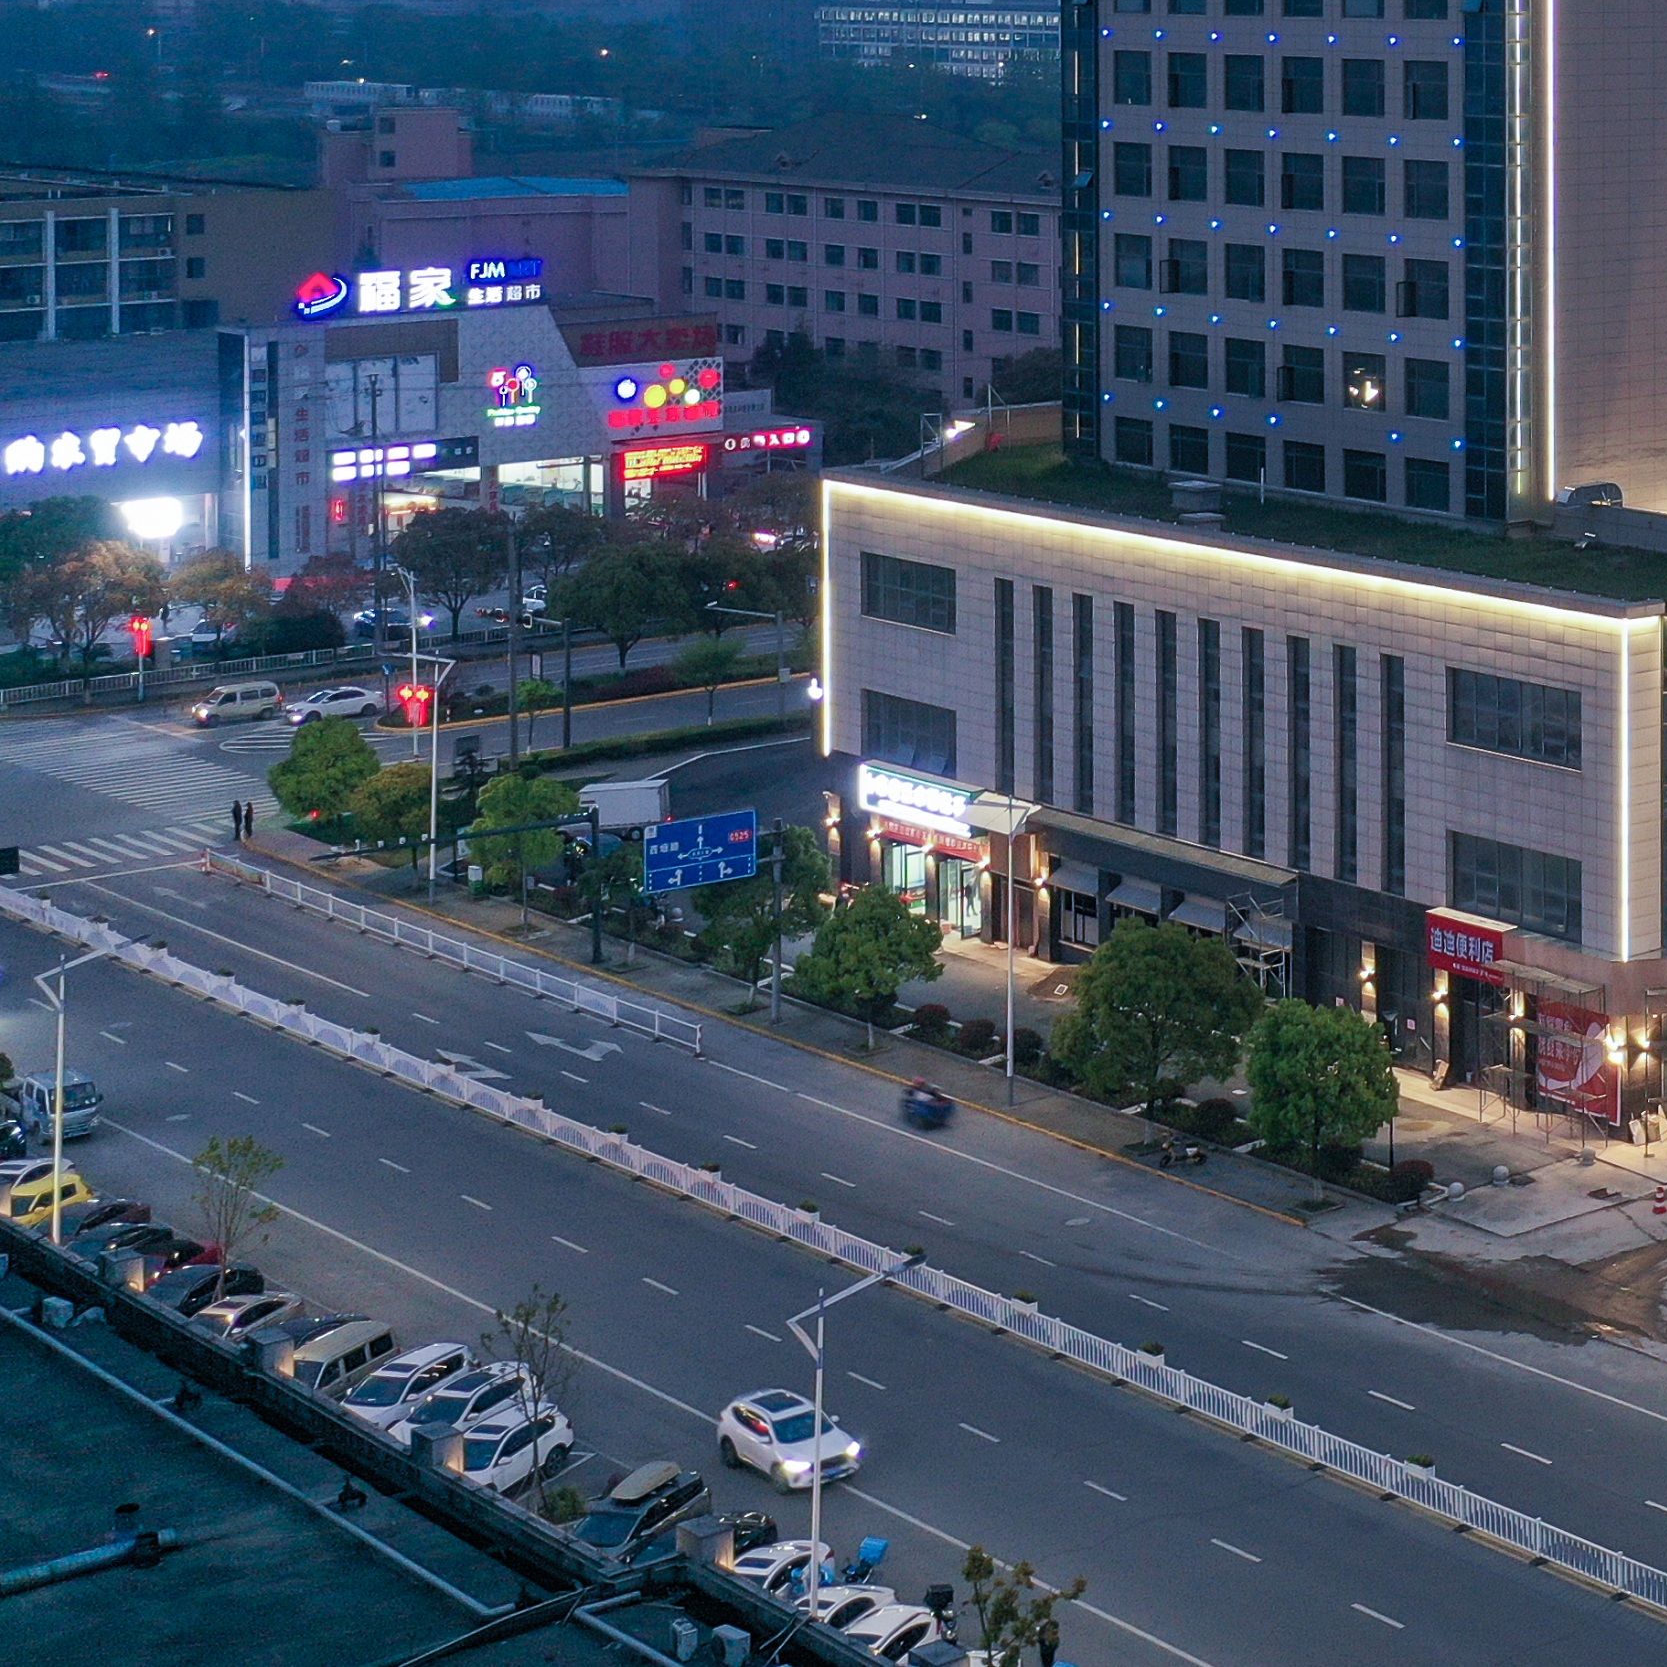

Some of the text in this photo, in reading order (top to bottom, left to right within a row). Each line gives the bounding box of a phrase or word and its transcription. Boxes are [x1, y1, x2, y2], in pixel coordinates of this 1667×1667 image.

[358, 267, 456, 312] 福家
[467, 284, 541, 305] 生活超市
[1430, 927, 1494, 965] 迪迪便利店
